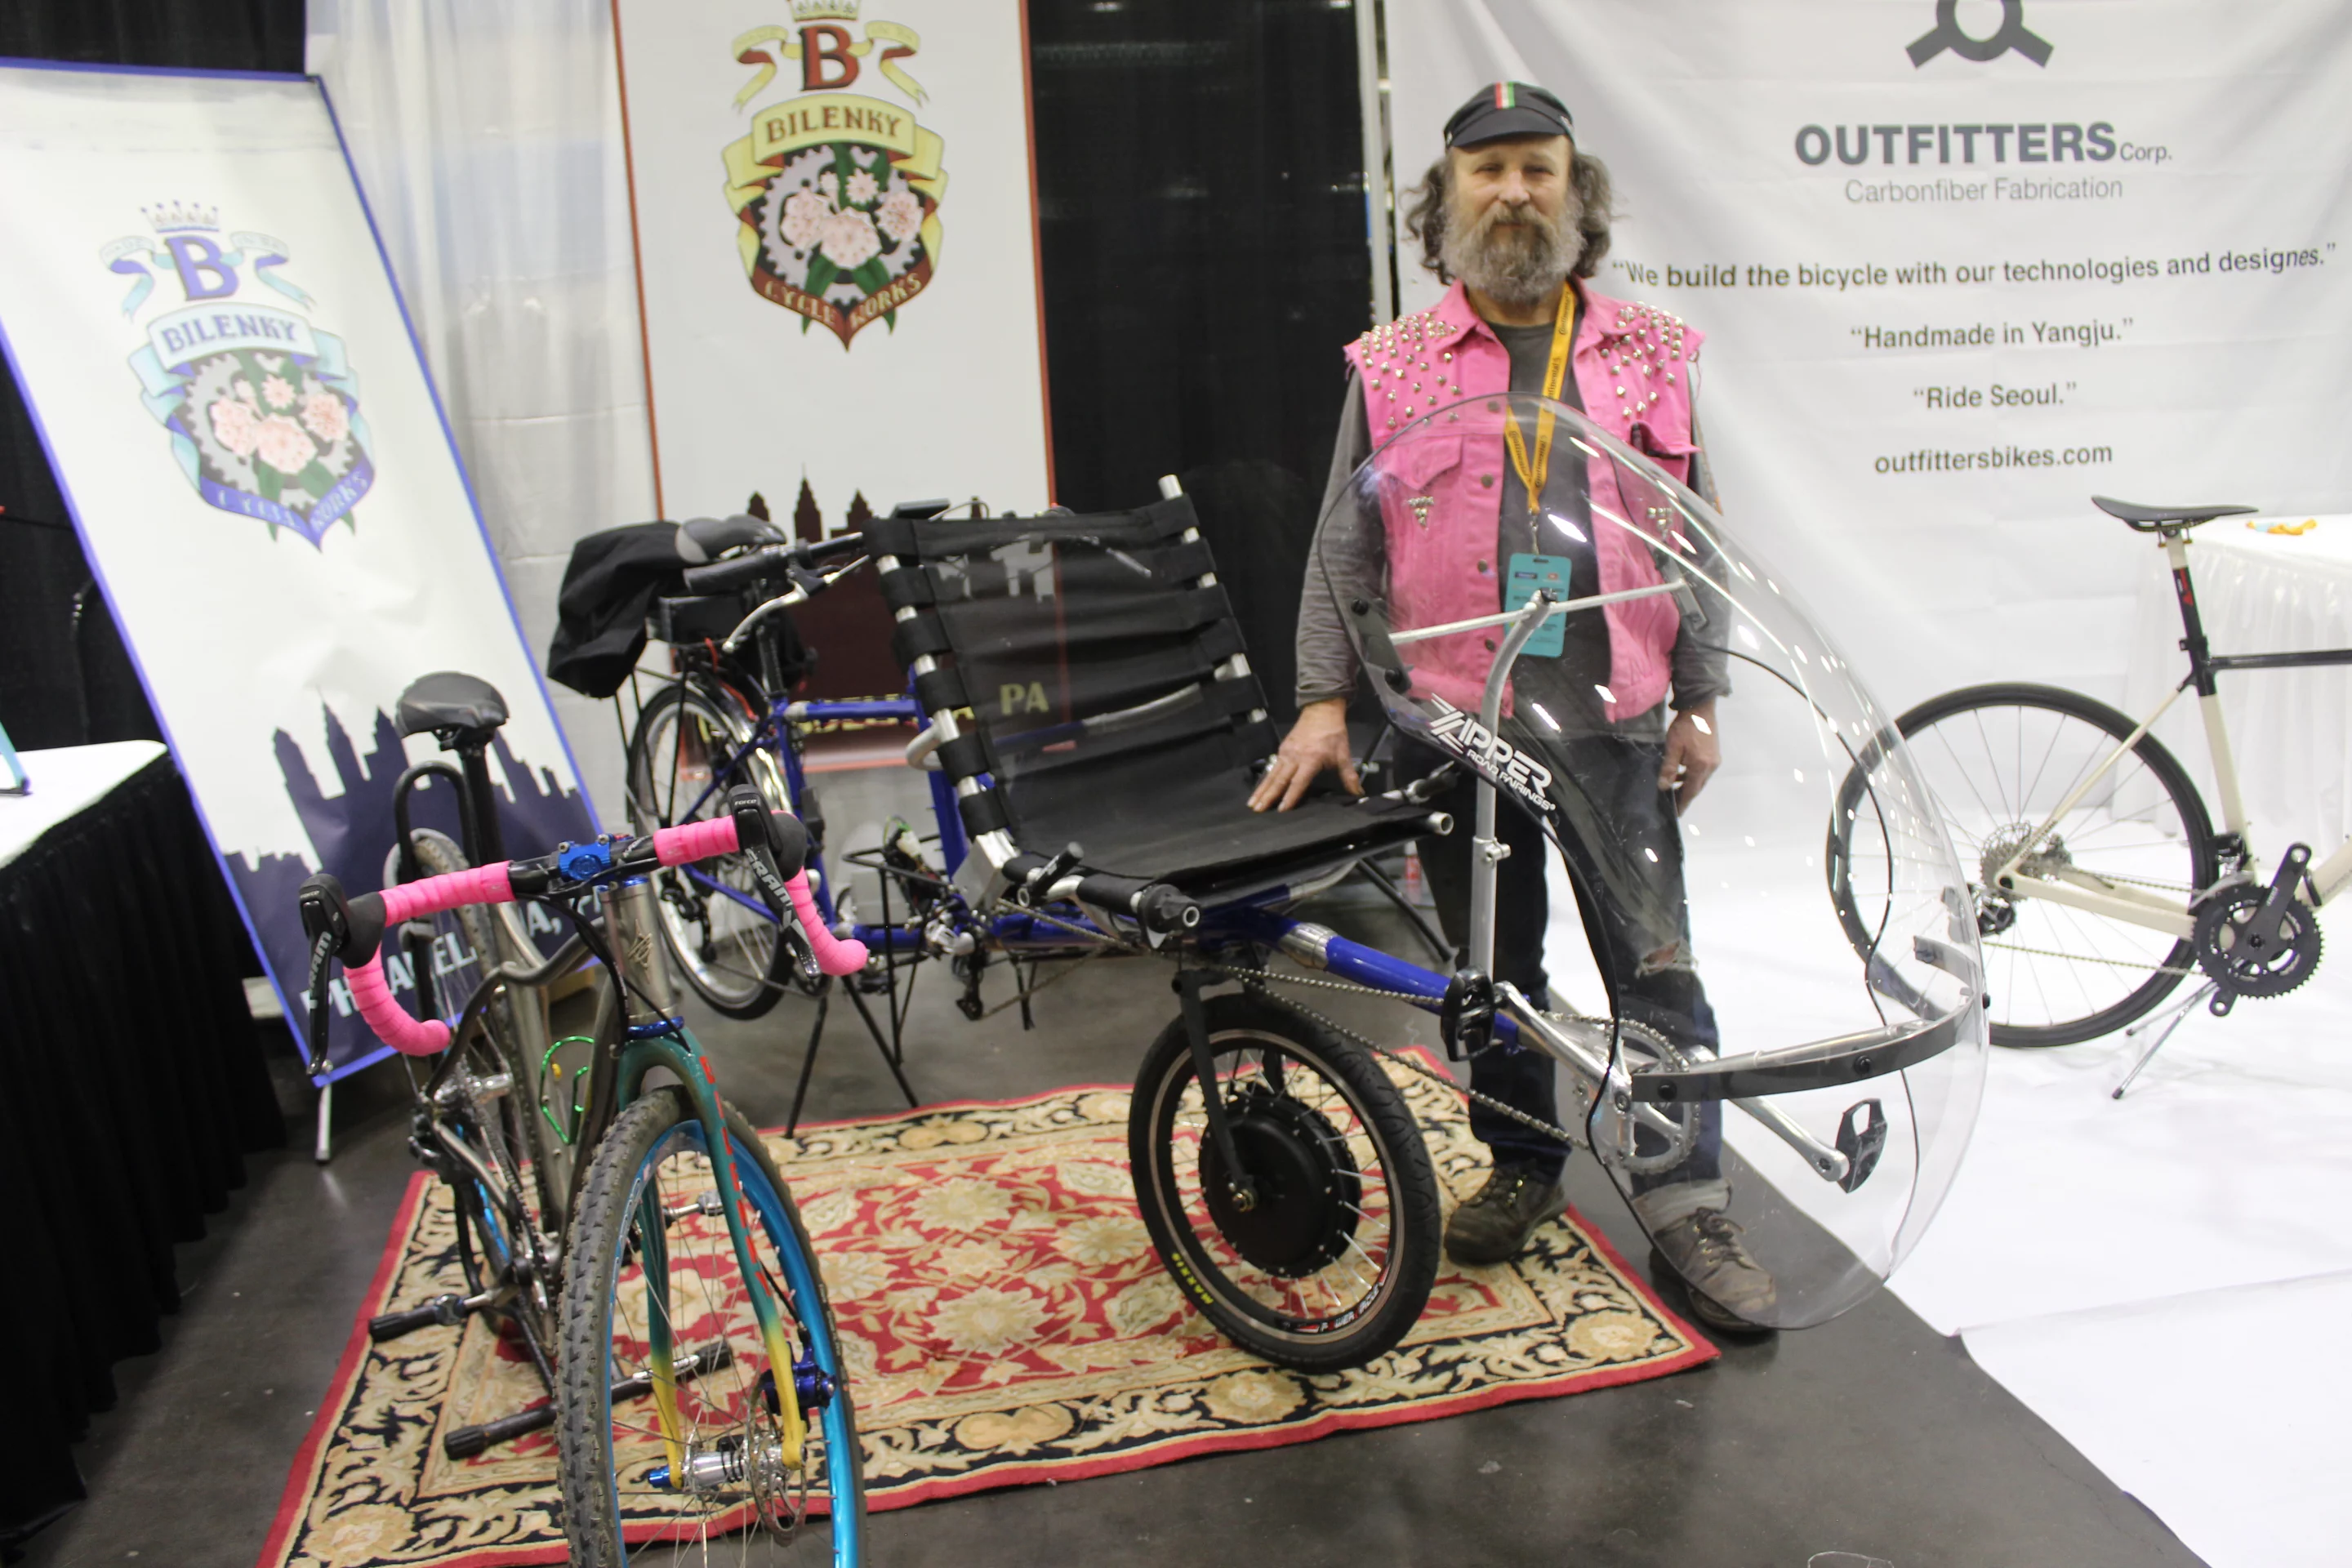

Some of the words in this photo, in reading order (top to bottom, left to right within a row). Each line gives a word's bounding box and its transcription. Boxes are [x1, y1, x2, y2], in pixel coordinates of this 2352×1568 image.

[798, 24, 860, 91] B
[764, 105, 901, 144] BILENKY
[1795, 121, 2118, 166] OUTFITTERS
[2119, 142, 2172, 164] Corp.
[1845, 178, 1988, 203] Carbonfiber
[1995, 177, 2123, 200] Fabrication
[164, 234, 239, 301] B
[1667, 264, 1737, 287] build
[1747, 264, 1791, 286] the
[1798, 262, 1887, 292] bicycle
[1895, 261, 1946, 284] with
[1956, 265, 1995, 283] our
[2003, 256, 2158, 283] technologies
[2167, 252, 2211, 276] and
[849, 272, 922, 330] WORKS
[161, 314, 297, 354] BILENKY
[2003, 322, 2025, 344] in
[1874, 445, 2114, 474] outfittersbikes.com
[1467, 748, 1499, 774] ROAD
